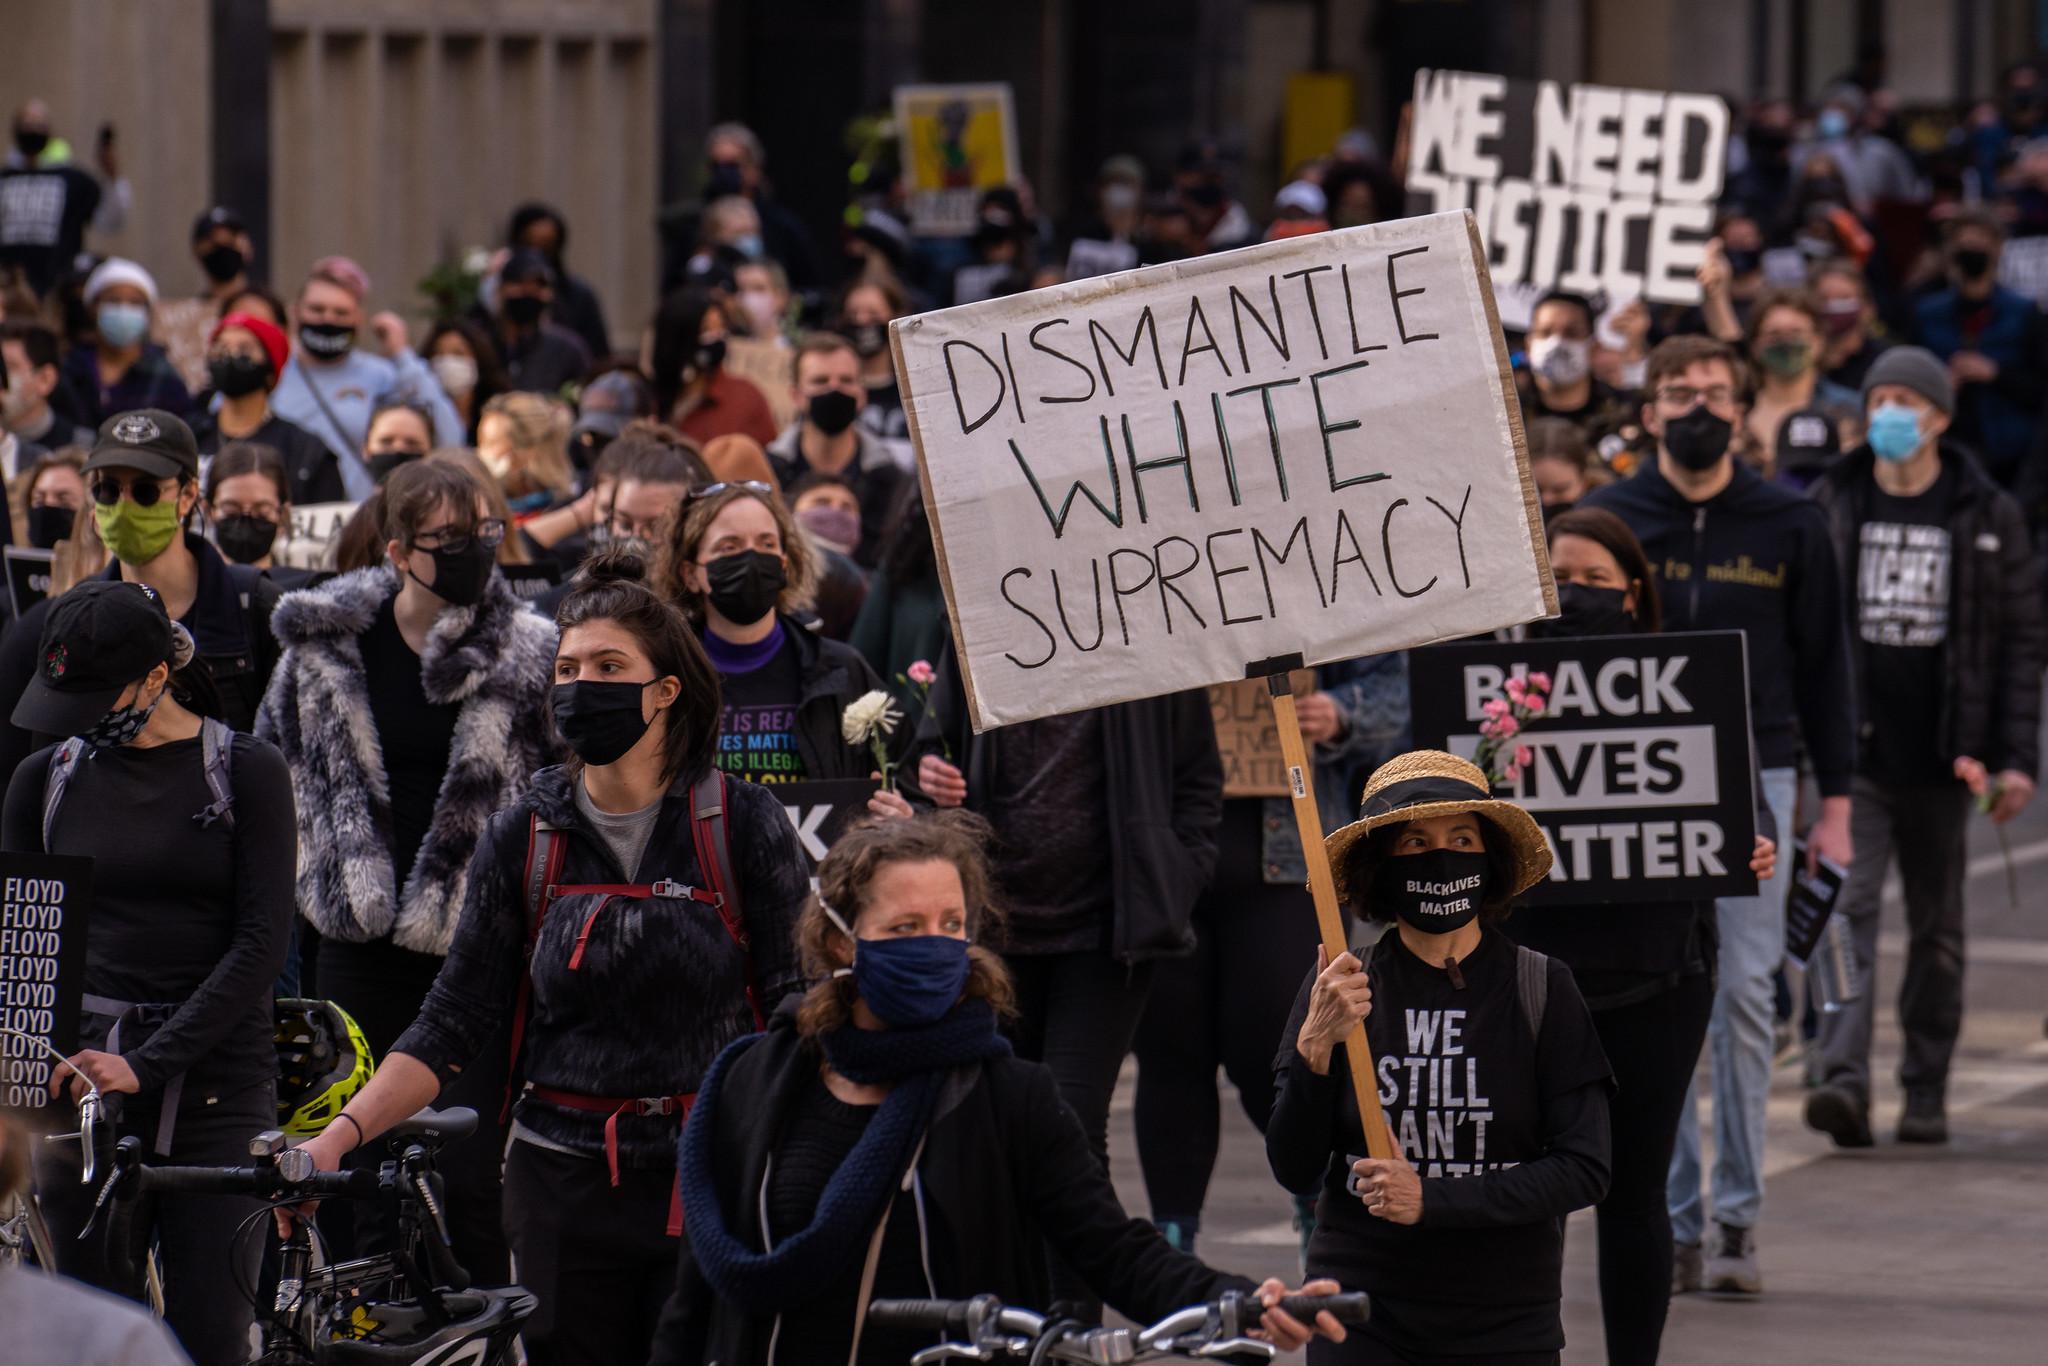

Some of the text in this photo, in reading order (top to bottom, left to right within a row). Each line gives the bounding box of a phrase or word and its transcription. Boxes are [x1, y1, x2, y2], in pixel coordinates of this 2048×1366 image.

[1410, 68, 1730, 201] WE NEED
[943, 246, 1440, 434] DISMANTLE
[1007, 361, 1392, 538] WHITE
[1001, 485, 1471, 669] SUPREMACY
[759, 711, 796, 732] REA
[1546, 820, 1729, 882] TTER
[4, 877, 65, 905] FLOYD
[1420, 898, 1471, 916] MATTER
[2, 903, 63, 930] FLOYD
[0, 929, 61, 956] FLOYD
[0, 956, 59, 982] FLOYD
[0, 1033, 51, 1060] LOYD
[1405, 1008, 1467, 1056] WE
[0, 1060, 49, 1086] LOYD
[1377, 1055, 1489, 1108] STILL
[1383, 1109, 1493, 1161] AN'T
